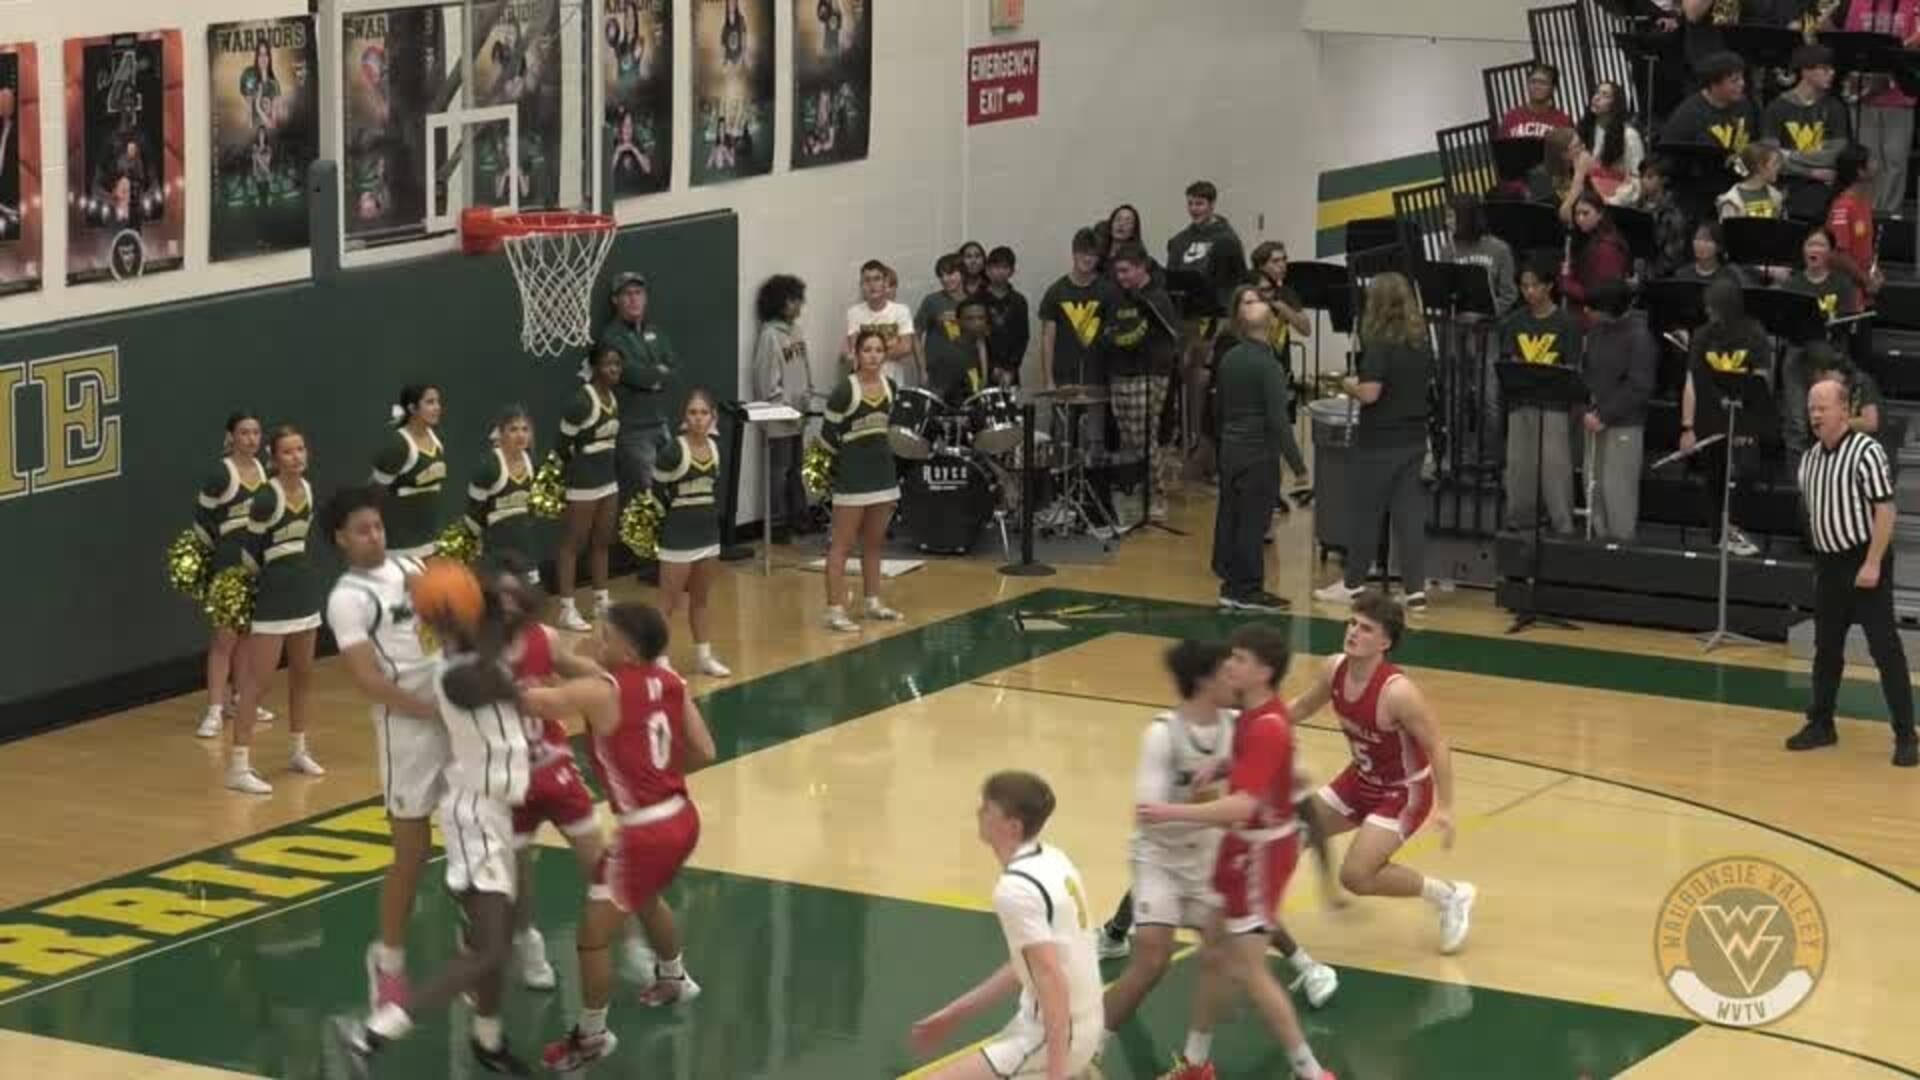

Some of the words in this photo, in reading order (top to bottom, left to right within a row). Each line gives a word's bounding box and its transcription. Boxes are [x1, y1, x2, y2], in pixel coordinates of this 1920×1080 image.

[971, 47, 1037, 82] EMERGENCY
[980, 86, 1005, 115] EXIT
[648, 710, 672, 770] 0
